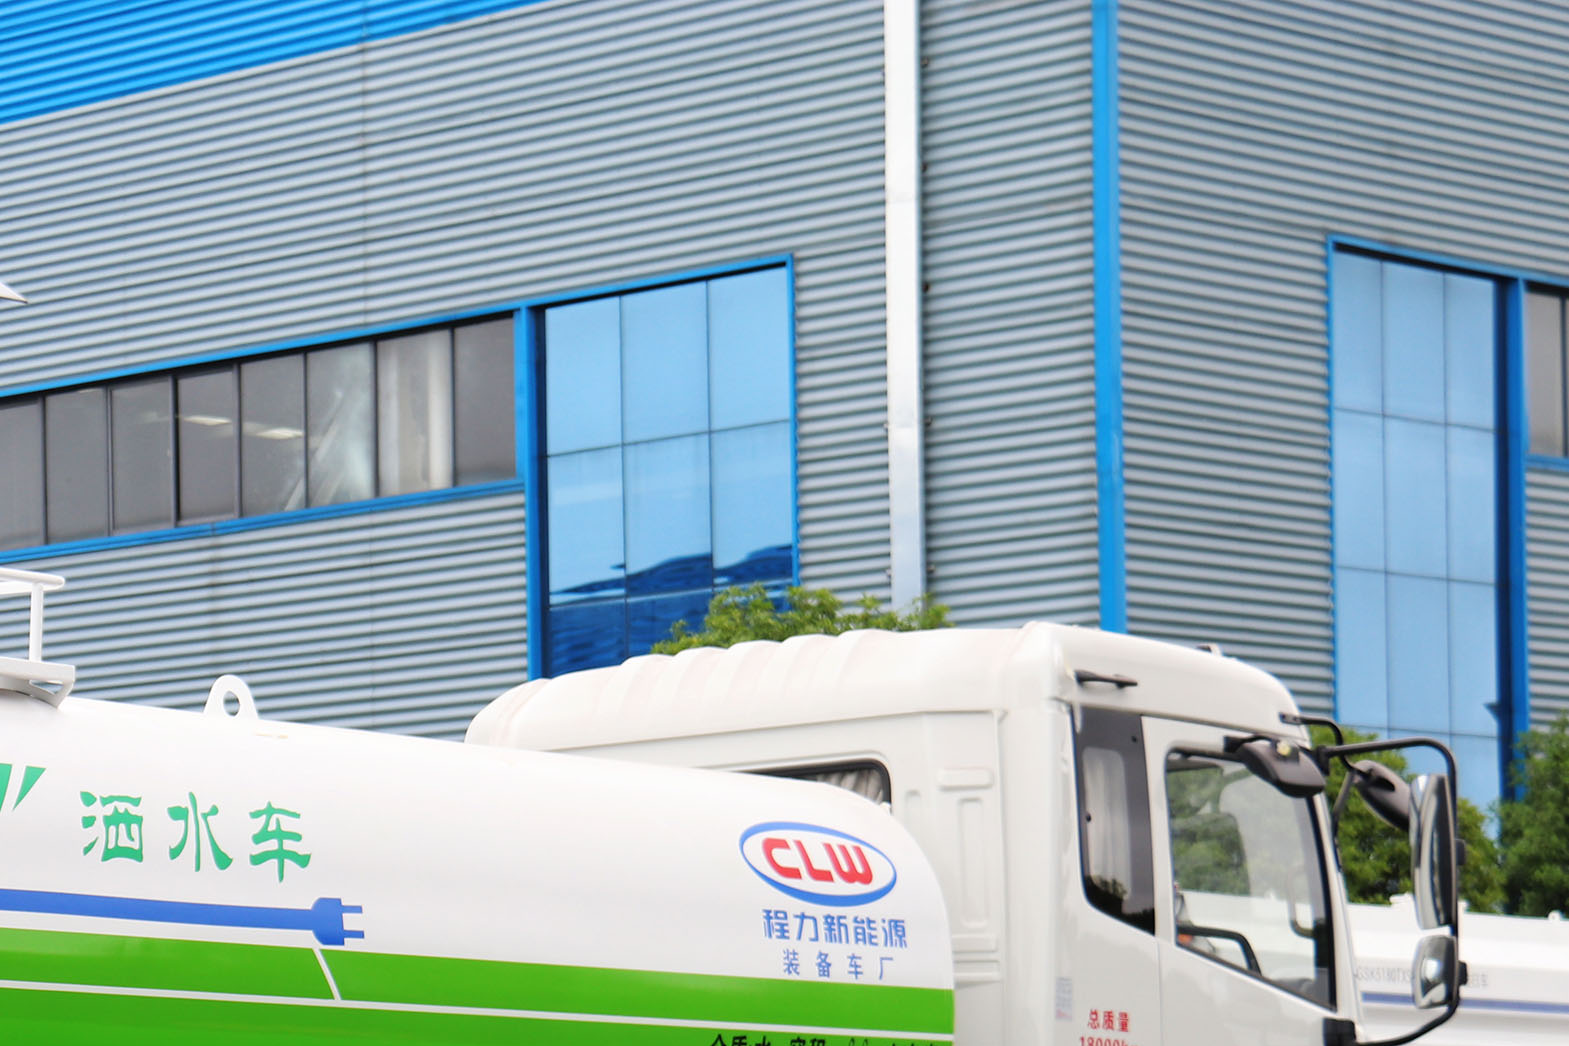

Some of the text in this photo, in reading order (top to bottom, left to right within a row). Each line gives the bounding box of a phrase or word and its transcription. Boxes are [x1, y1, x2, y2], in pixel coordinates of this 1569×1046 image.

[80, 791, 312, 883] 洒水车
[762, 837, 873, 885] CLW
[762, 909, 908, 948] 程力新能源
[783, 949, 894, 980] 装备车厂
[1088, 1008, 1130, 1032] 总质量
